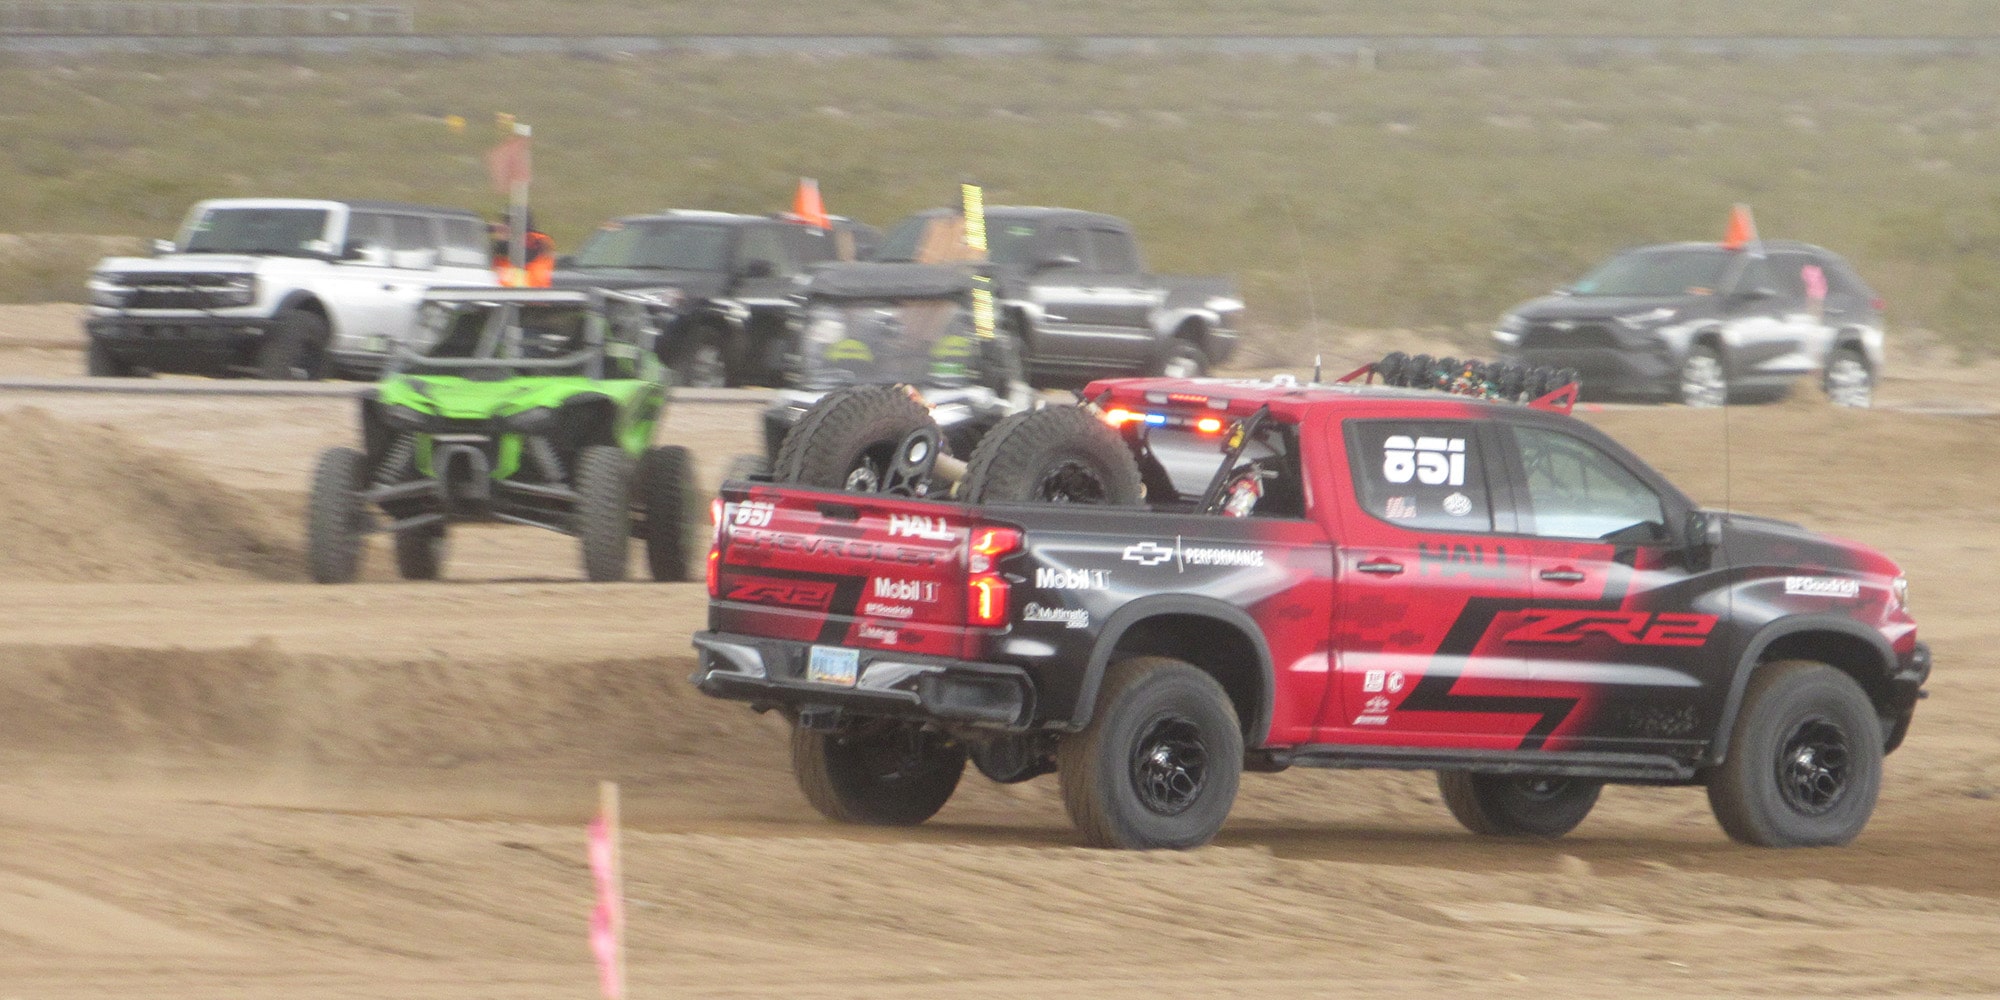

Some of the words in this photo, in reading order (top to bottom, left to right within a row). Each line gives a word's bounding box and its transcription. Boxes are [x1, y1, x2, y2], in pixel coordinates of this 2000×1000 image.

[1383, 435, 1465, 486] 851
[888, 513, 955, 541] HALL
[1185, 548, 1264, 567] PERFORMANCE
[874, 577, 920, 600] Mobil
[1036, 567, 1090, 588] Mobil
[1785, 576, 1860, 596] BFGoodrich
[1502, 607, 1720, 648] ZR2
